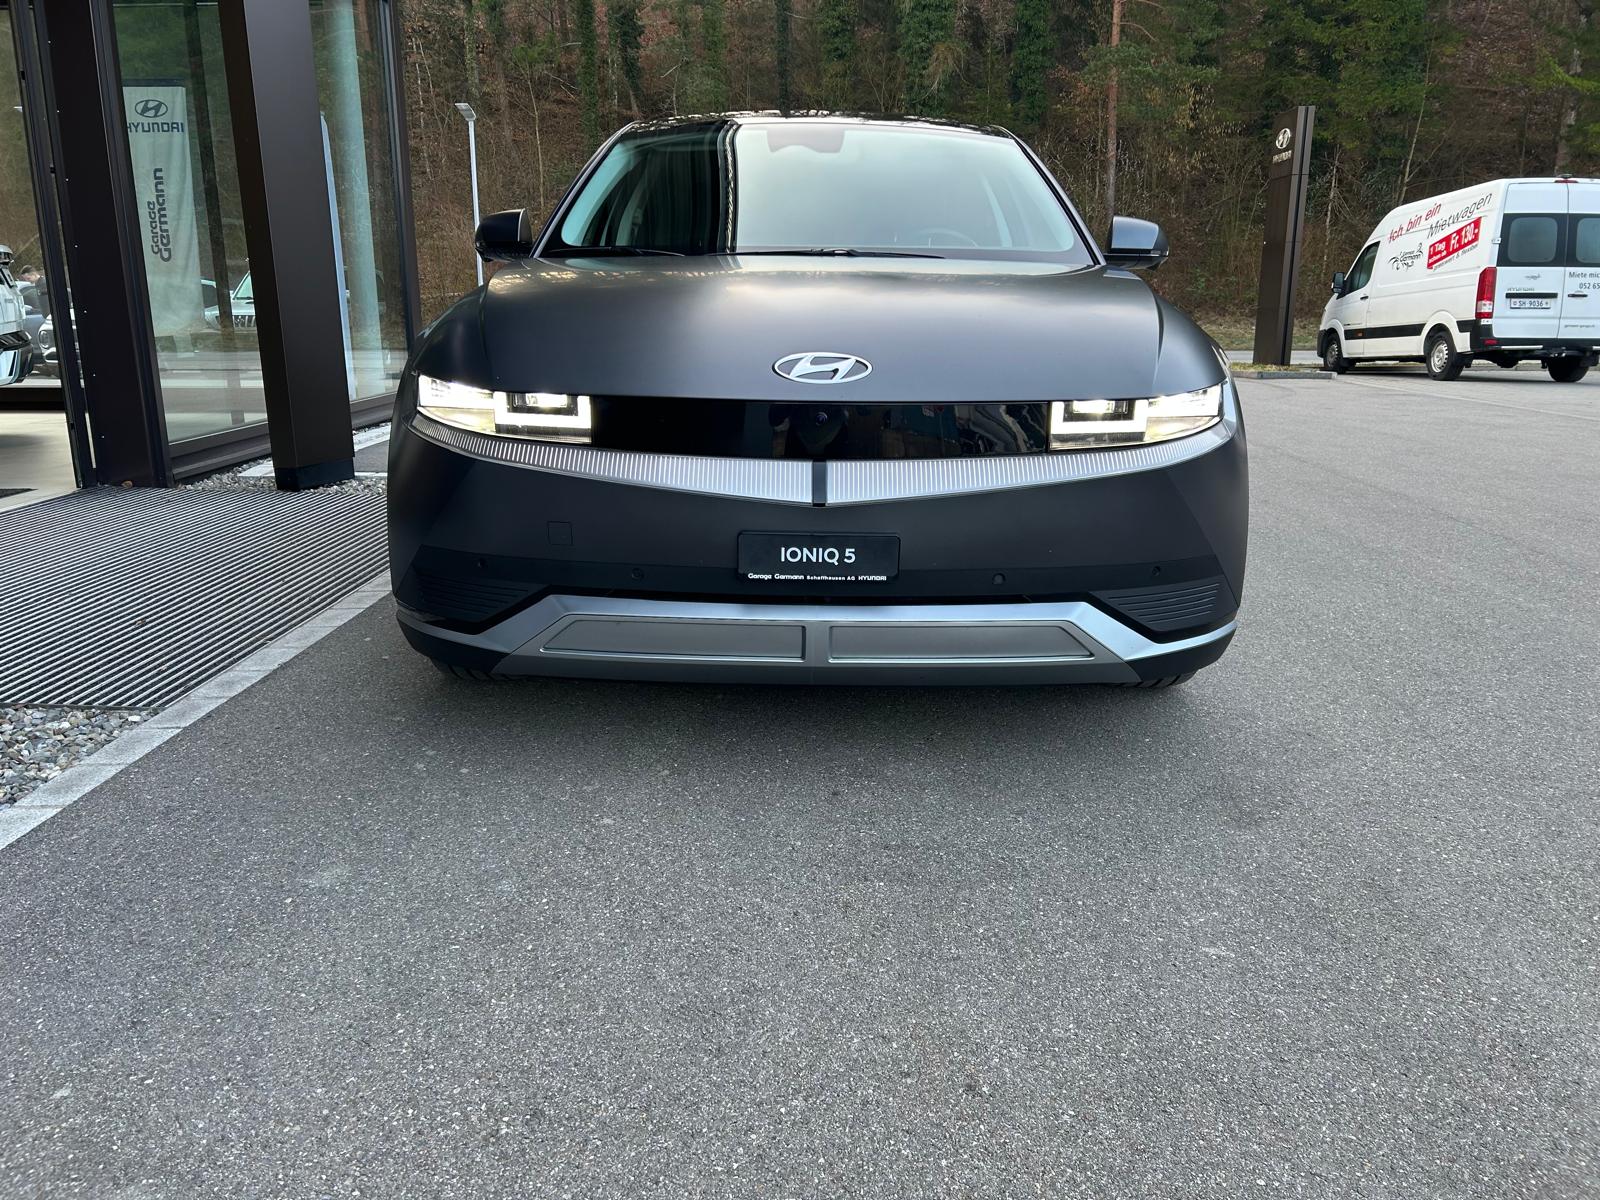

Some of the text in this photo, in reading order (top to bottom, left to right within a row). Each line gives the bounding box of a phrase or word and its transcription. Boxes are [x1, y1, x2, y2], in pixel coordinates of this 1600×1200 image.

[153, 167, 172, 263] Germann
[1389, 202, 1442, 243] Ich bin ein
[1427, 193, 1493, 239] Mietwagen
[147, 200, 160, 255] Garage
[1435, 241, 1446, 252] Tag
[1568, 271, 1587, 279] Miete
[1578, 282, 1591, 290] 052
[780, 547, 856, 566] IONIQ 5
[747, 573, 772, 581] Garage
